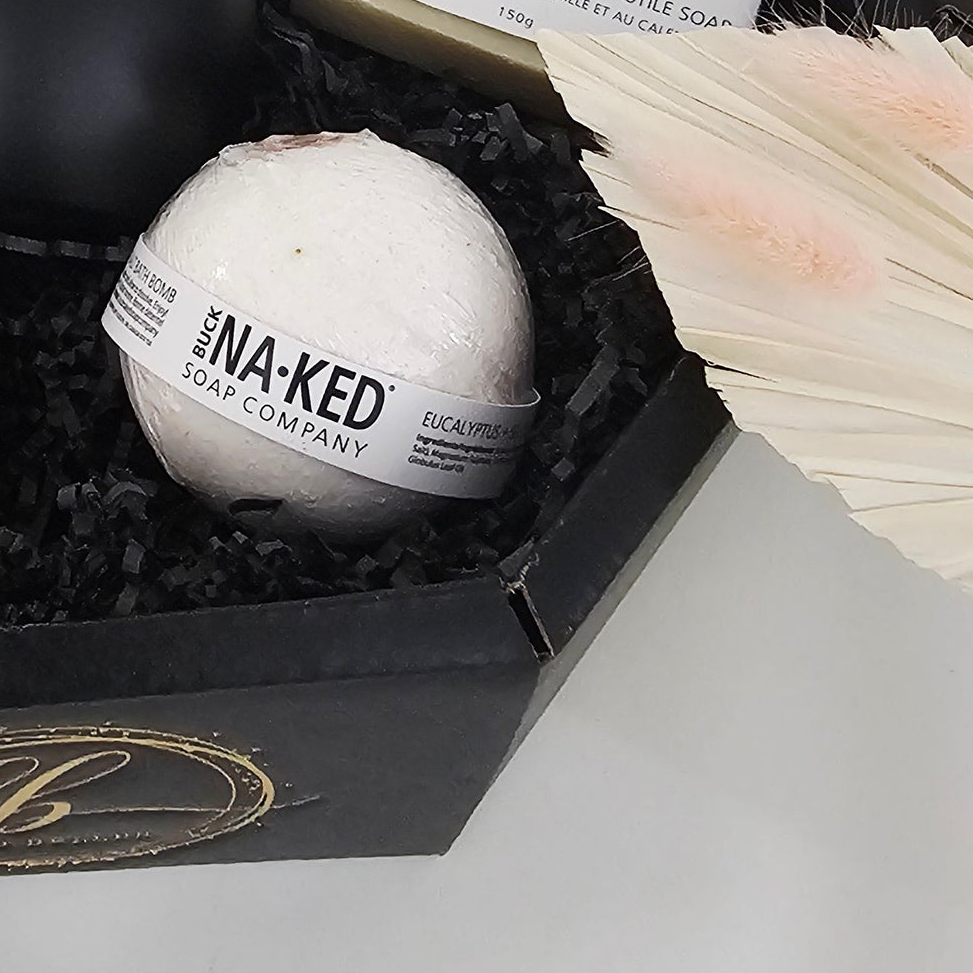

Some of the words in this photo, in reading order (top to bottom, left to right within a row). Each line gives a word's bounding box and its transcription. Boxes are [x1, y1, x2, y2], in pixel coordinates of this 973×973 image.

[498, 6, 534, 30] 150g
[593, 3, 611, 17] ET
[612, 11, 634, 26] AU
[148, 273, 177, 303] BOMB
[192, 305, 223, 359] BUCK
[181, 362, 236, 401] SOAP
[243, 396, 368, 458] COMPANY
